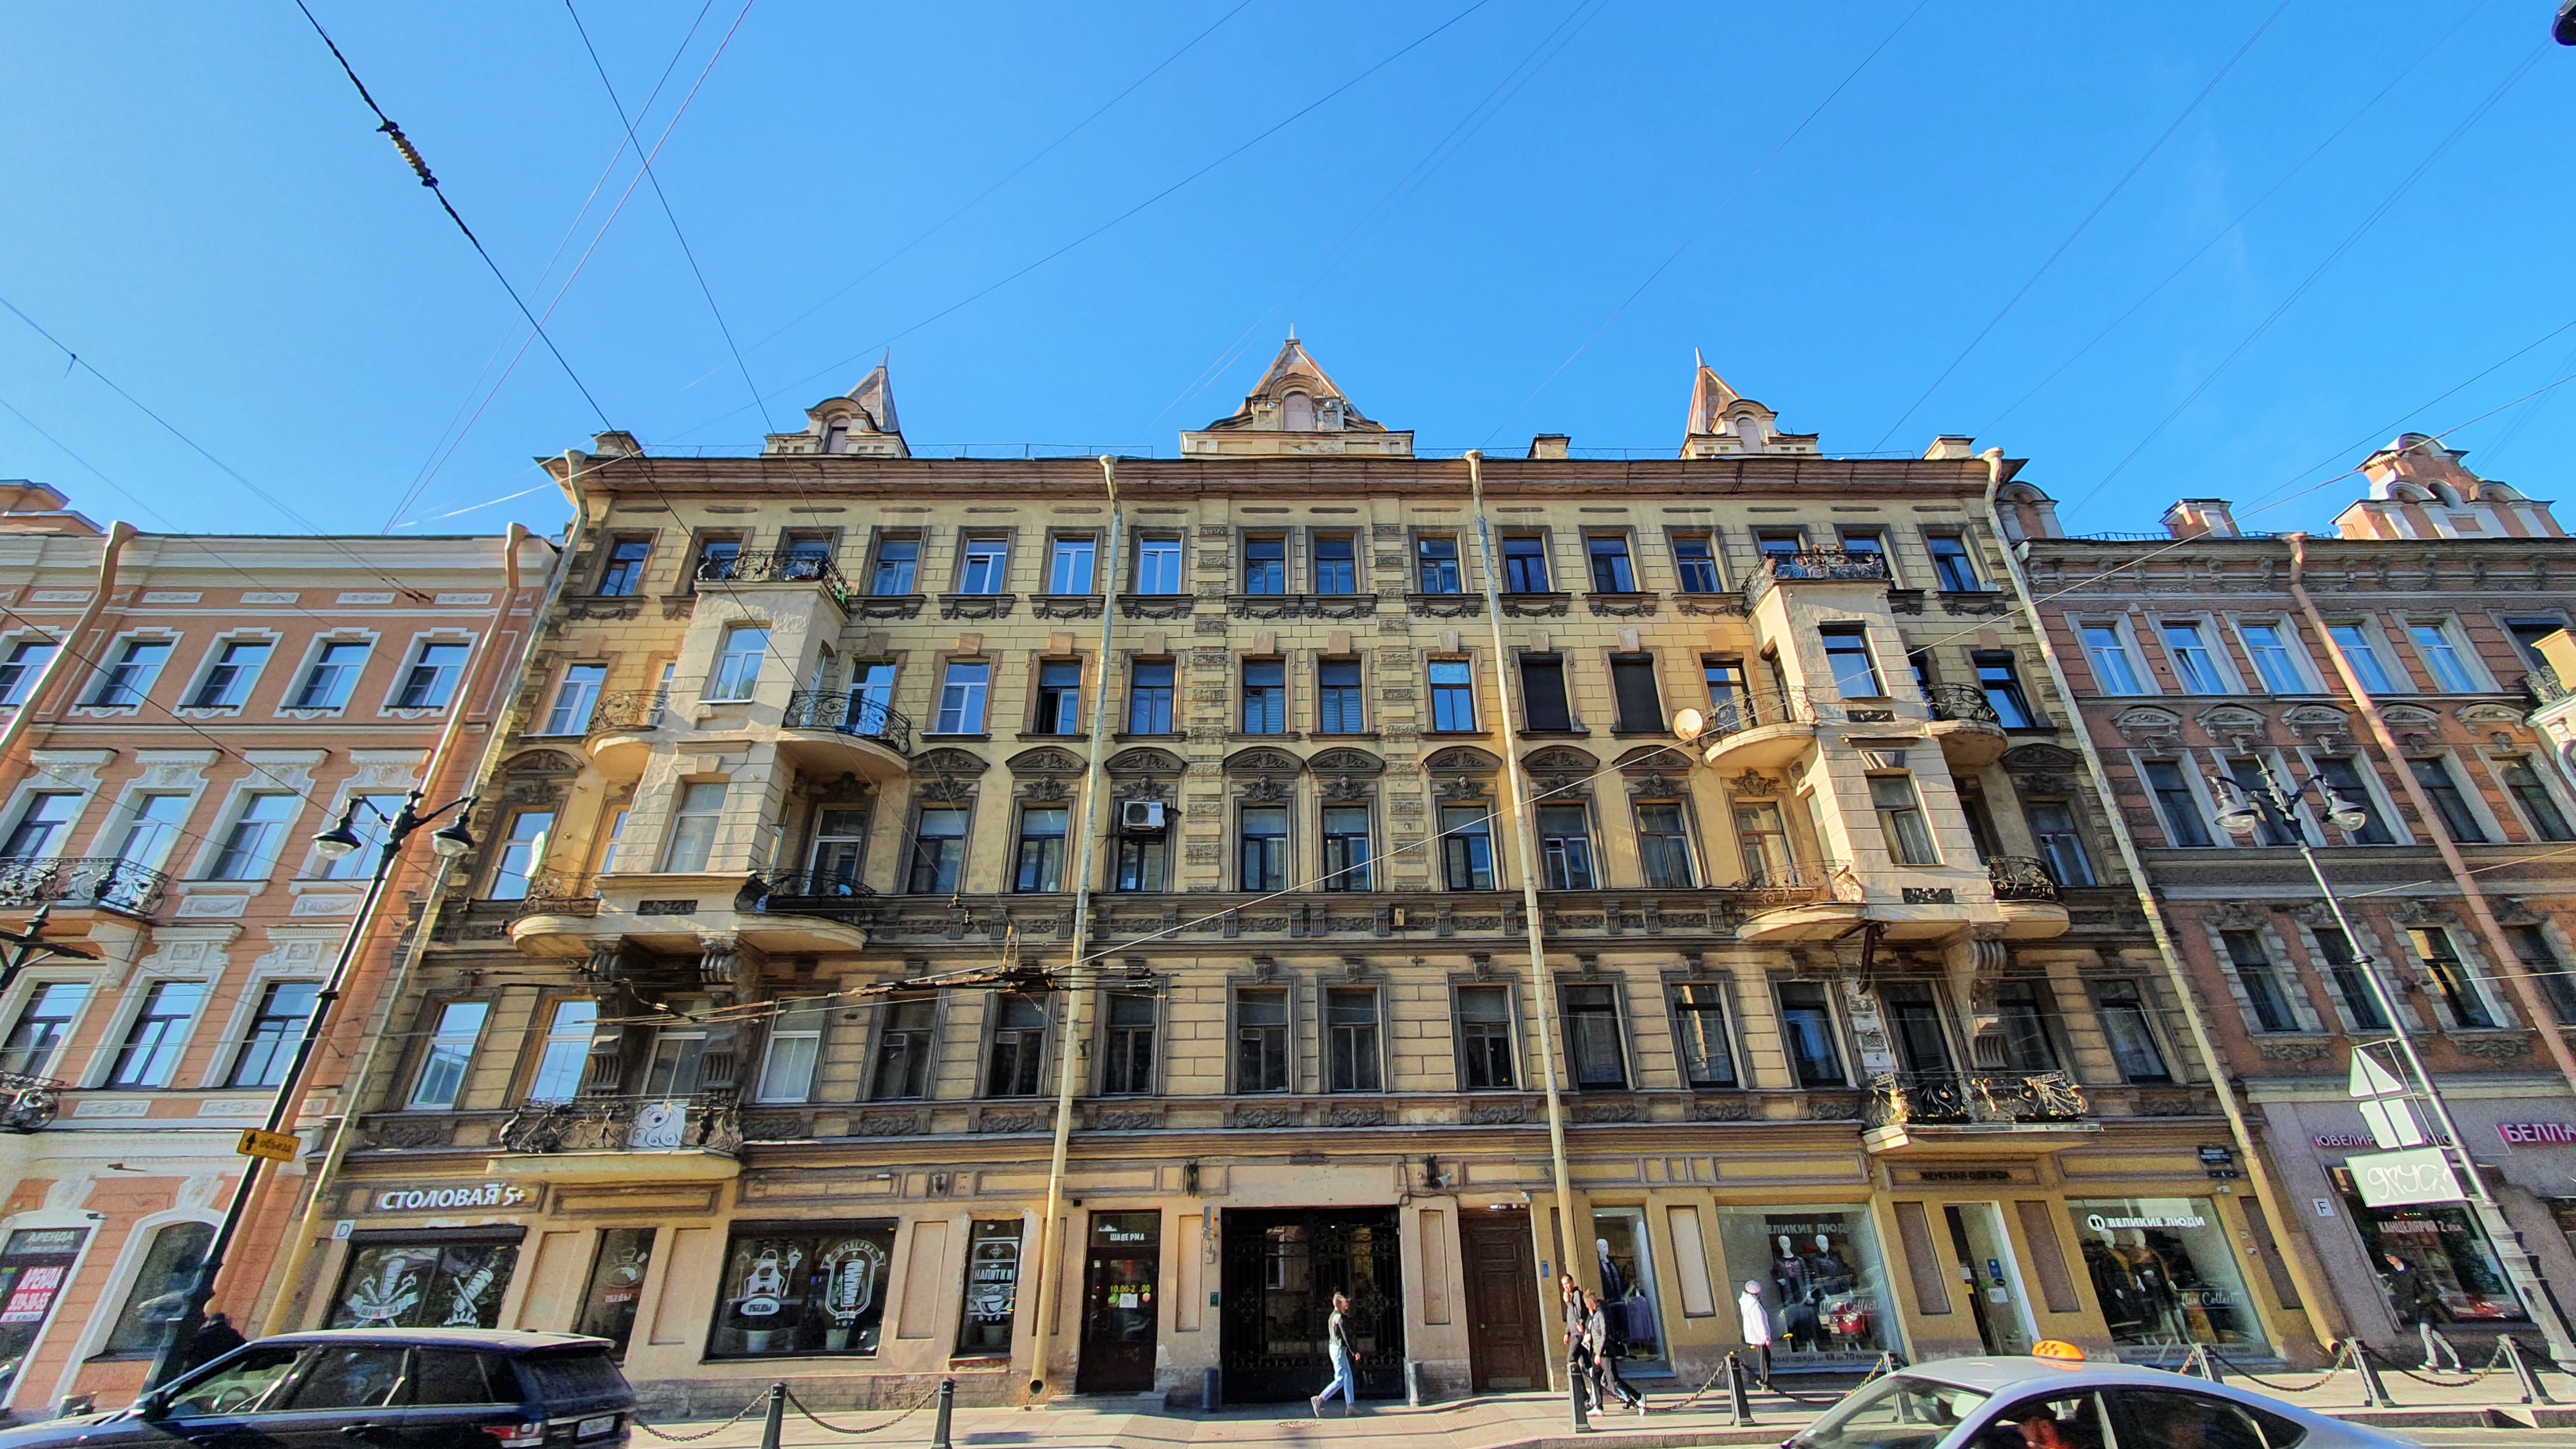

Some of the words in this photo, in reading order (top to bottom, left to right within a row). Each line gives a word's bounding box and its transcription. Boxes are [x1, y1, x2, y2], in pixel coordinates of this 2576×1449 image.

[381, 1186, 501, 1209] СТОЛОВАЯ
[502, 1186, 525, 1206] 5+
[2318, 1202, 2327, 1214] F
[2106, 1217, 2163, 1228] ВЕЛИКИЕ
[2164, 1216, 2206, 1228] ЛЮДИ
[2377, 1220, 2439, 1234] КАНЦЕЛЯРИЯ
[27, 1231, 75, 1242] АРЕНДА
[336, 1224, 350, 1237] D
[1110, 1232, 1144, 1241] ШАВЕРМА
[837, 1241, 875, 1255] ШАВЕРМА
[16, 1268, 64, 1291] АРЕНДА
[974, 1269, 1013, 1280] НАПИТКИ
[1825, 1352, 1836, 1361] 48
[1844, 1352, 1855, 1361] 70
